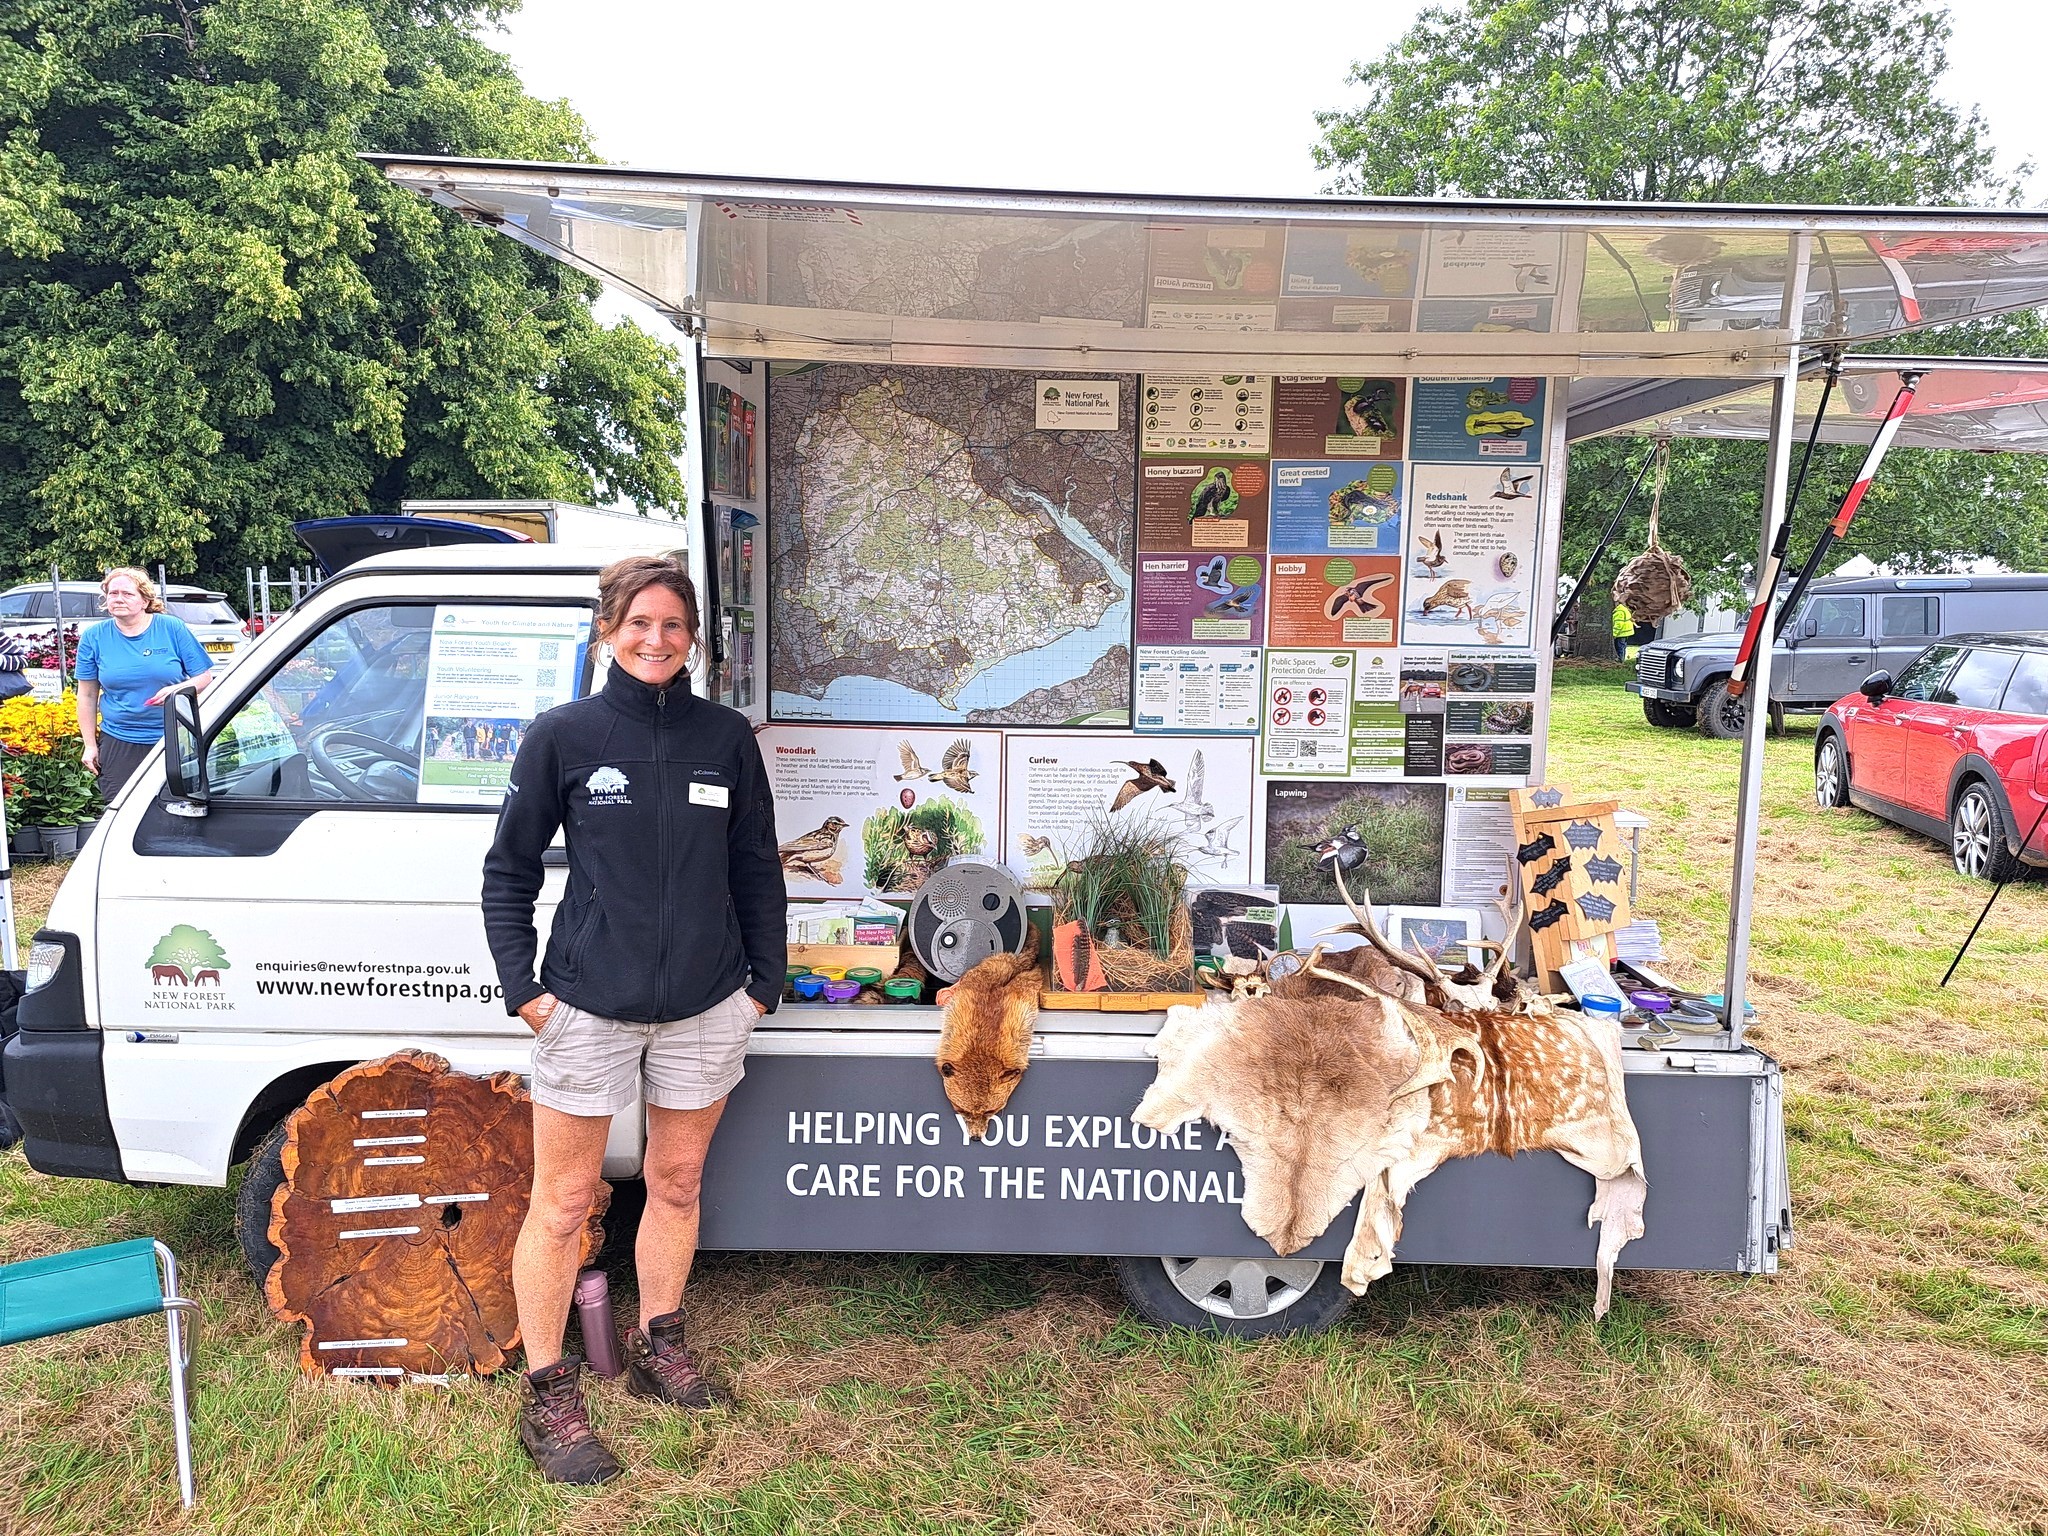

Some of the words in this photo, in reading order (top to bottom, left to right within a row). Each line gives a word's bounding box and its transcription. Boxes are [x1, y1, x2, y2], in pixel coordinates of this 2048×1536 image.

[735, 203, 835, 213] CAUTION
[1147, 468, 1171, 476] Honey
[1173, 467, 1202, 475] buzzard
[776, 746, 816, 754] Woodlark
[1275, 789, 1307, 799] Lapwing
[256, 961, 470, 976] enquiries@newforestnpa.gov.uk
[183, 992, 226, 1000] FOREST
[144, 1001, 202, 1009] NATIONAL
[207, 1002, 236, 1010] PARK
[788, 1111, 941, 1146] HELPING
[958, 1114, 1029, 1148] YOU
[1045, 1114, 1201, 1151] EXPLORE
[786, 1163, 880, 1197] CARE
[897, 1164, 965, 1198] FOR
[978, 1166, 1045, 1199] THE
[1060, 1167, 1243, 1204] NATIONAL
